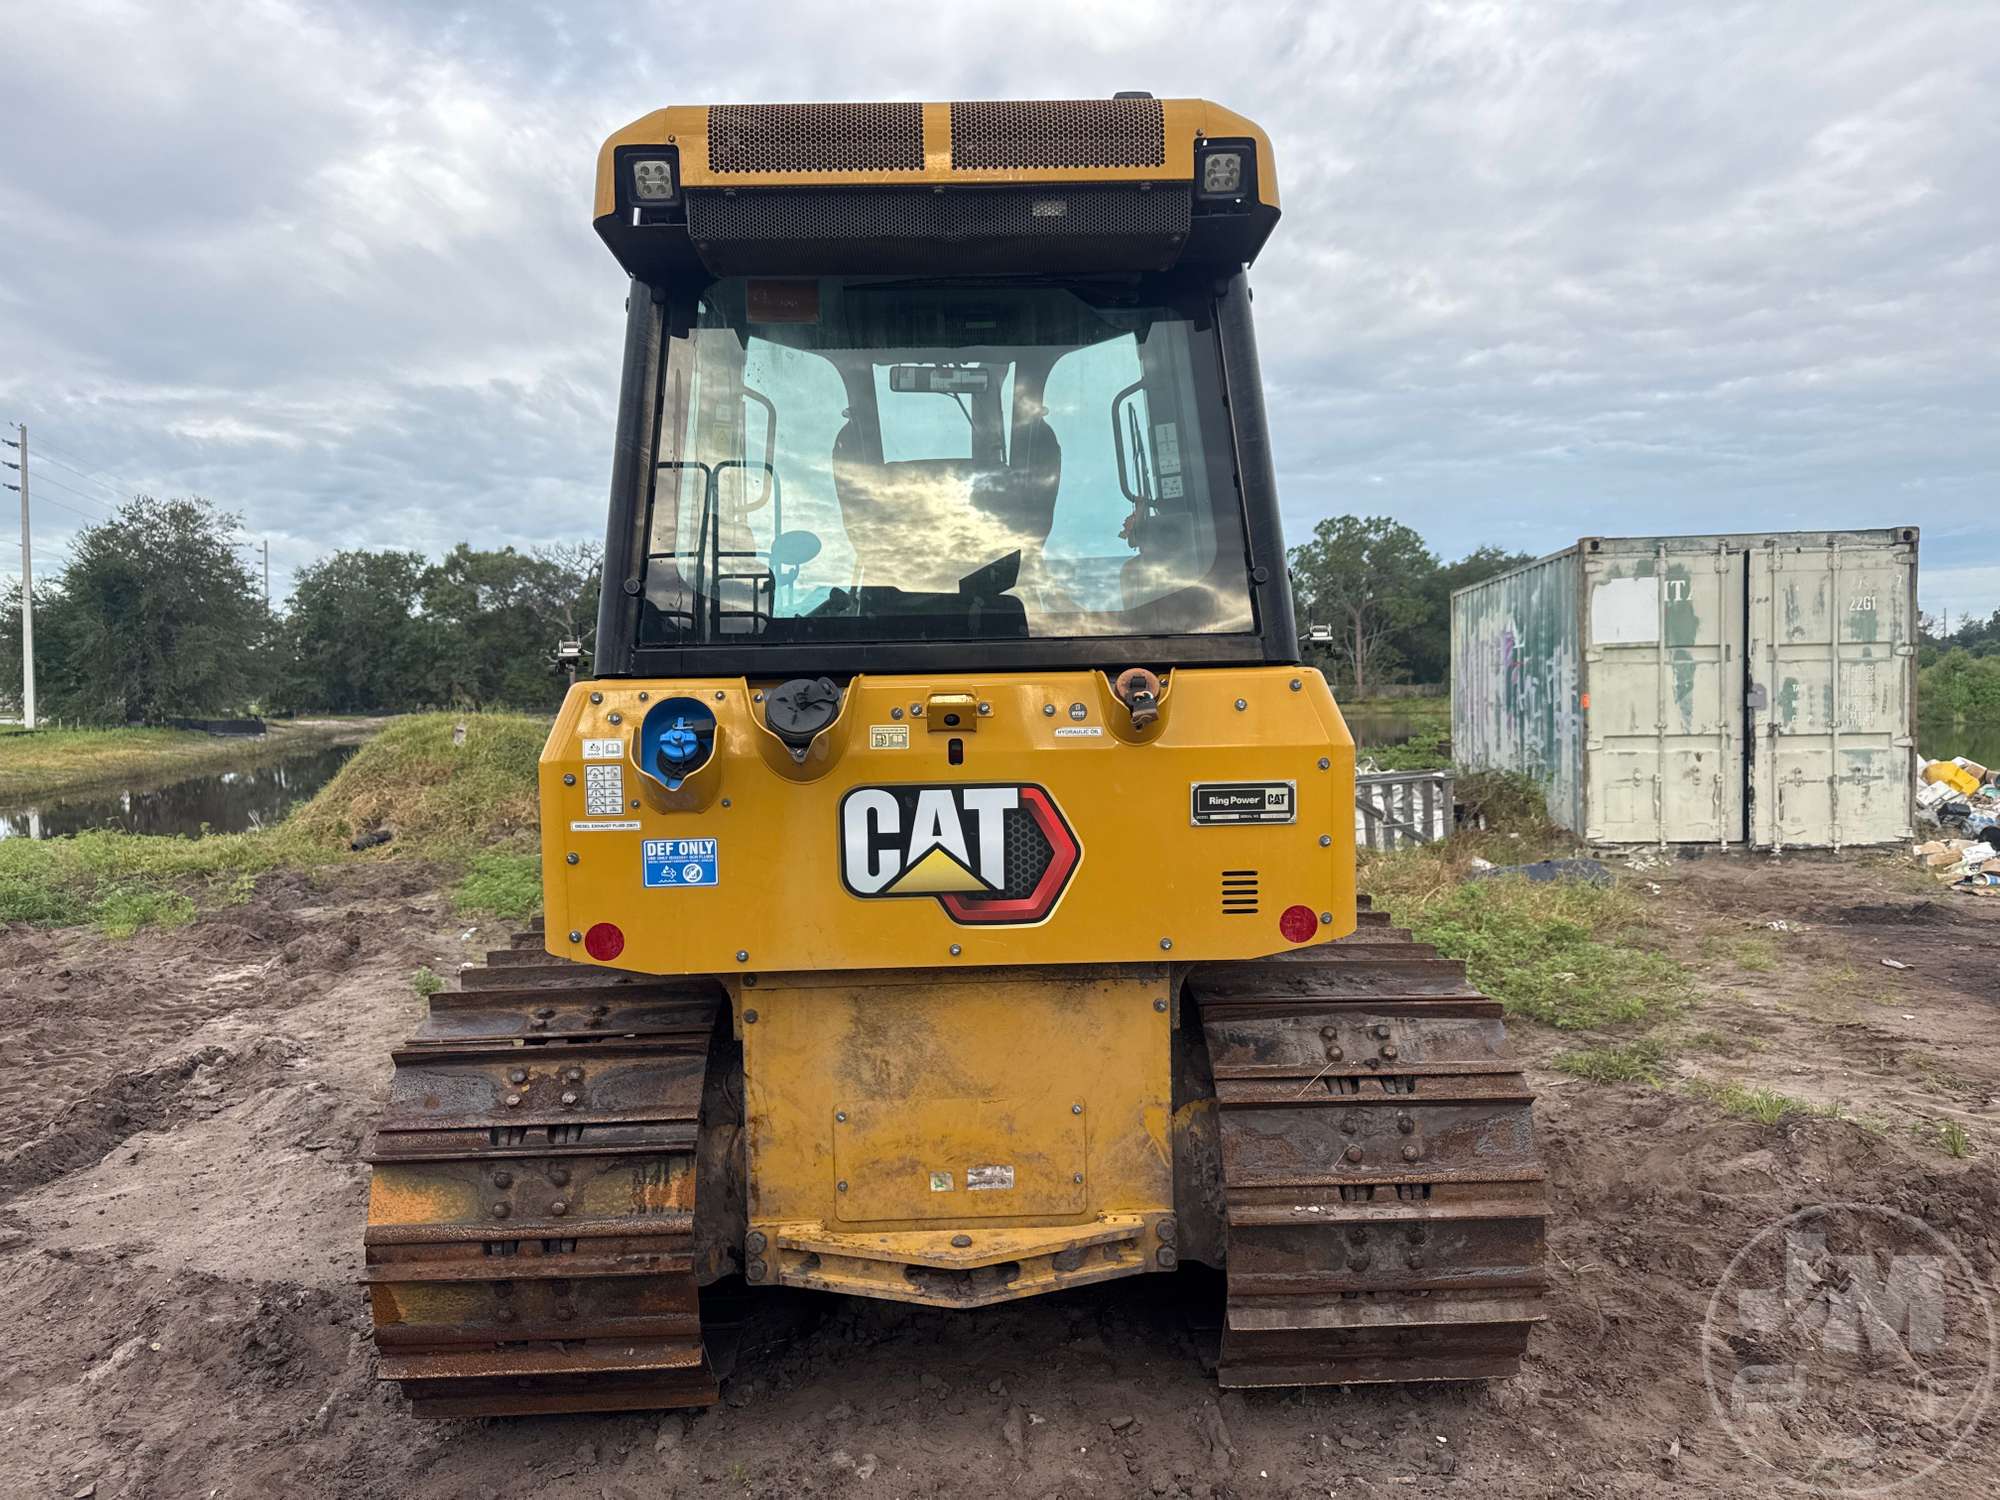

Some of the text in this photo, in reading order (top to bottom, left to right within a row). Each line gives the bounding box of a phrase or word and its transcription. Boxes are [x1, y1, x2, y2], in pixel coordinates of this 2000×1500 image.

[1209, 796, 1261, 806] Ring Power
[1267, 794, 1286, 805] CAT
[844, 788, 1019, 894] CAT
[647, 842, 714, 857] DEF ONLY
